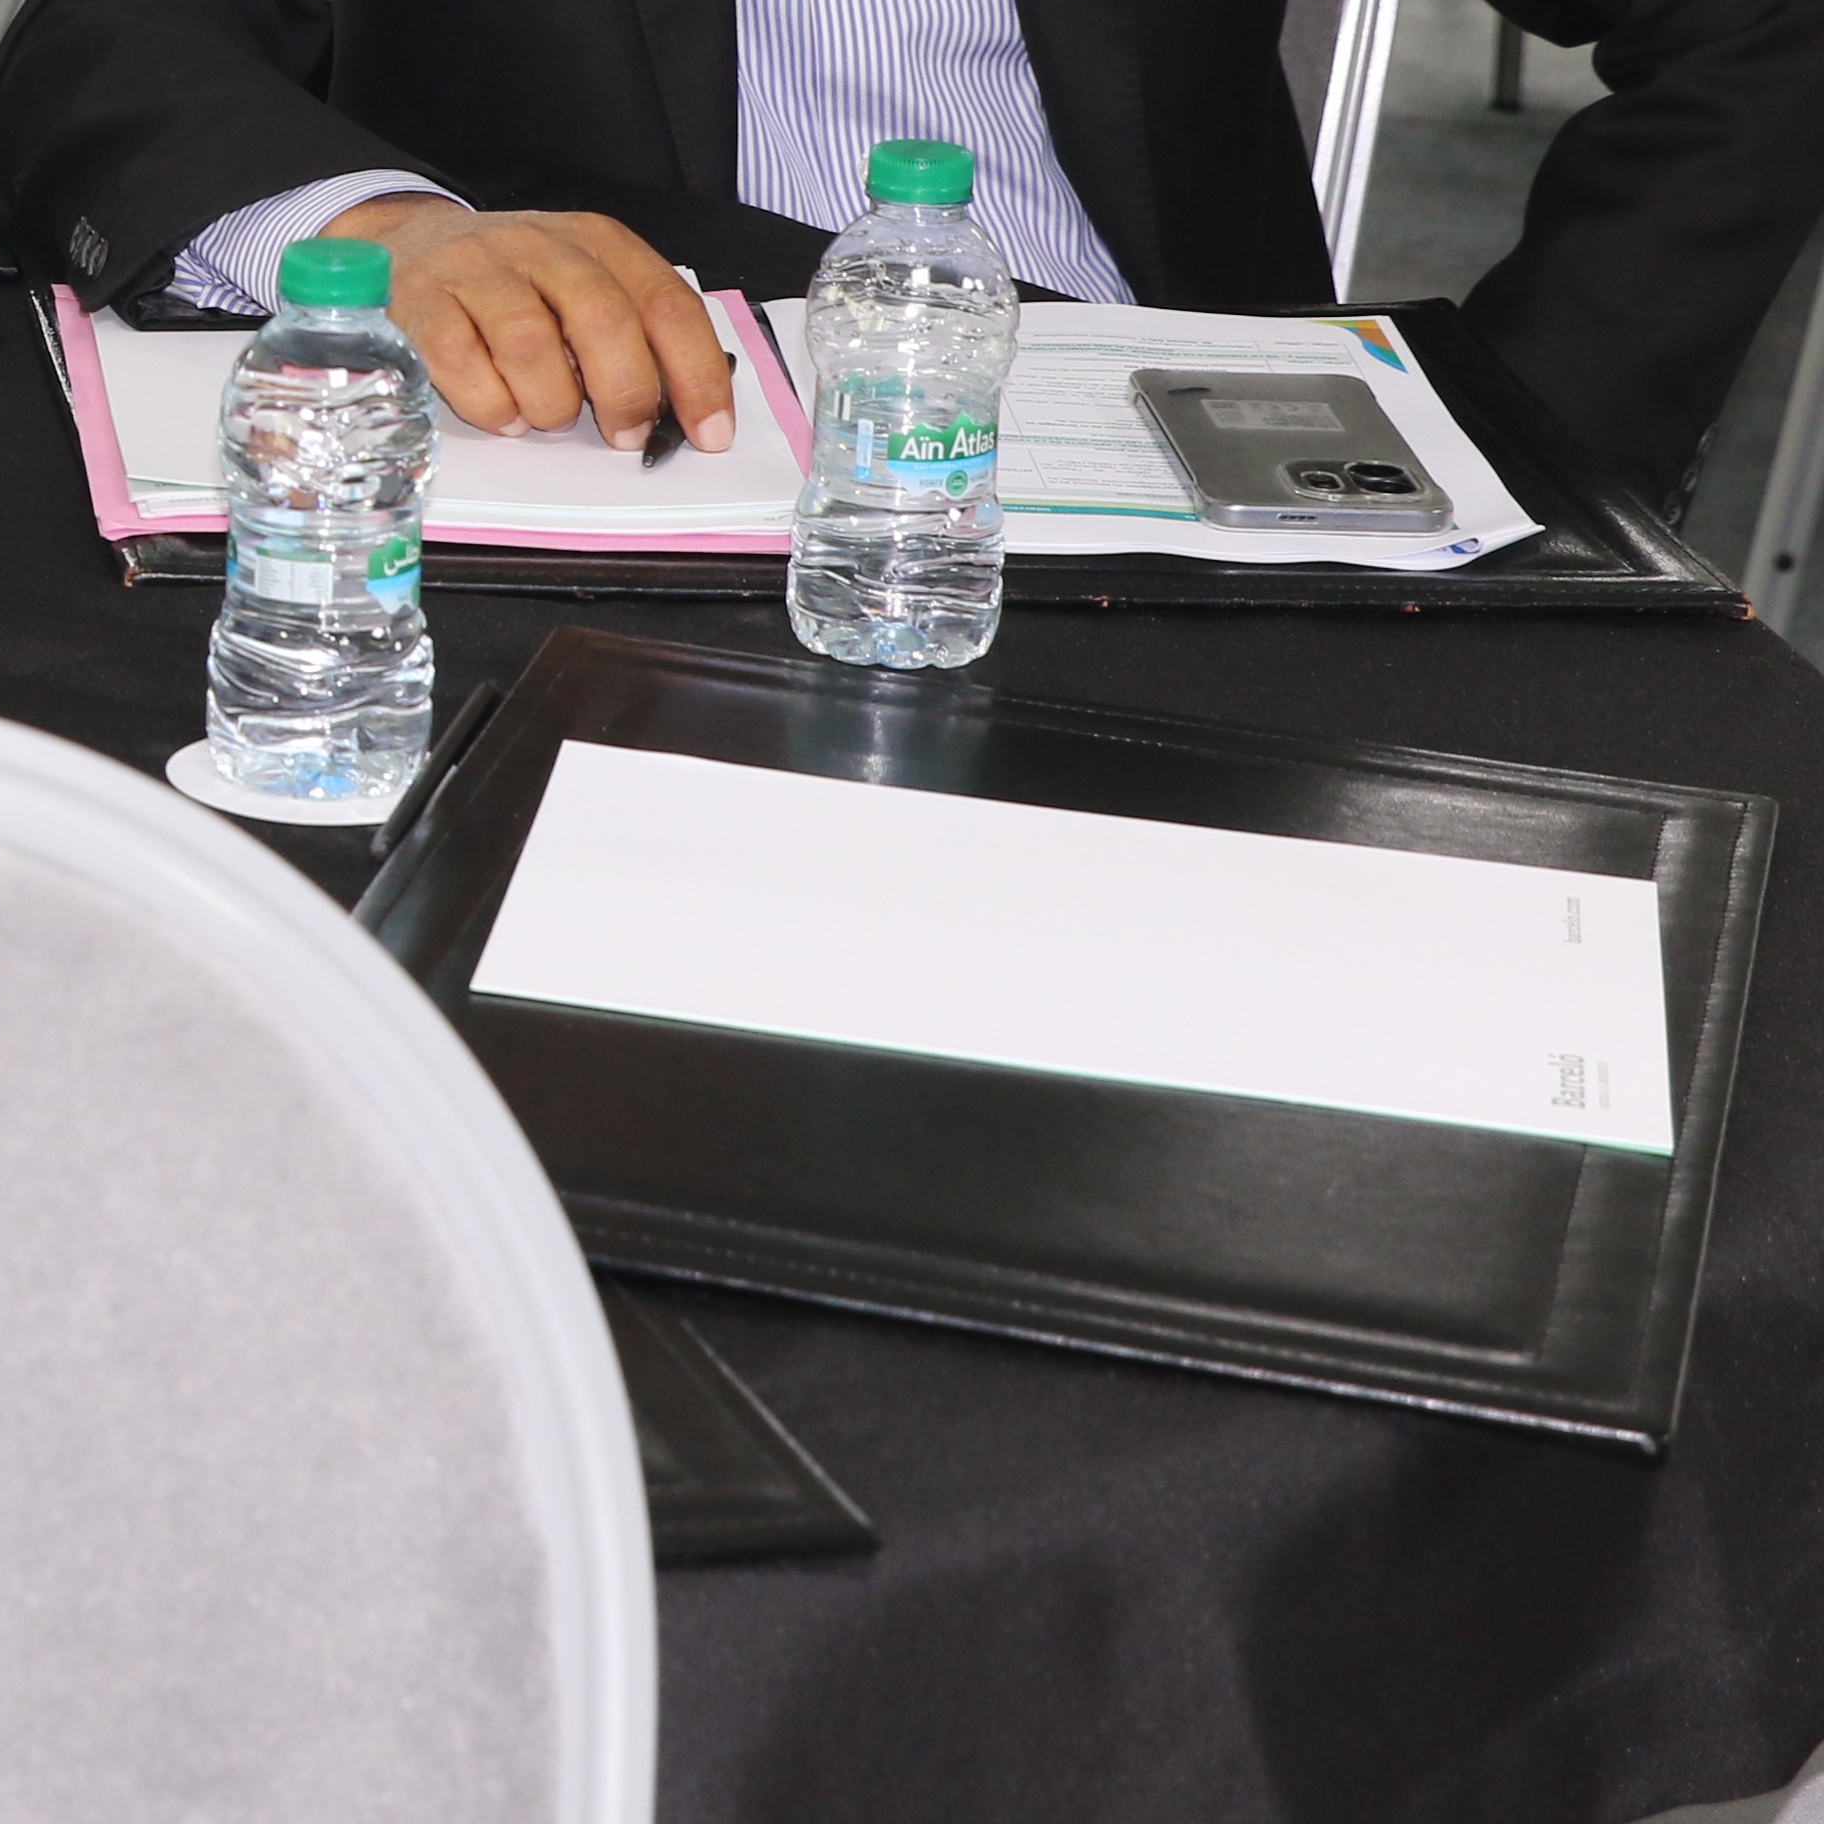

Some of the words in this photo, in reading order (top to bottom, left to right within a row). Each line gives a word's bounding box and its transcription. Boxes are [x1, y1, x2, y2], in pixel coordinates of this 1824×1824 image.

[900, 436, 944, 460] Aïn
[949, 427, 994, 459] Atlas
[1549, 1052, 1586, 1110] Barceló
